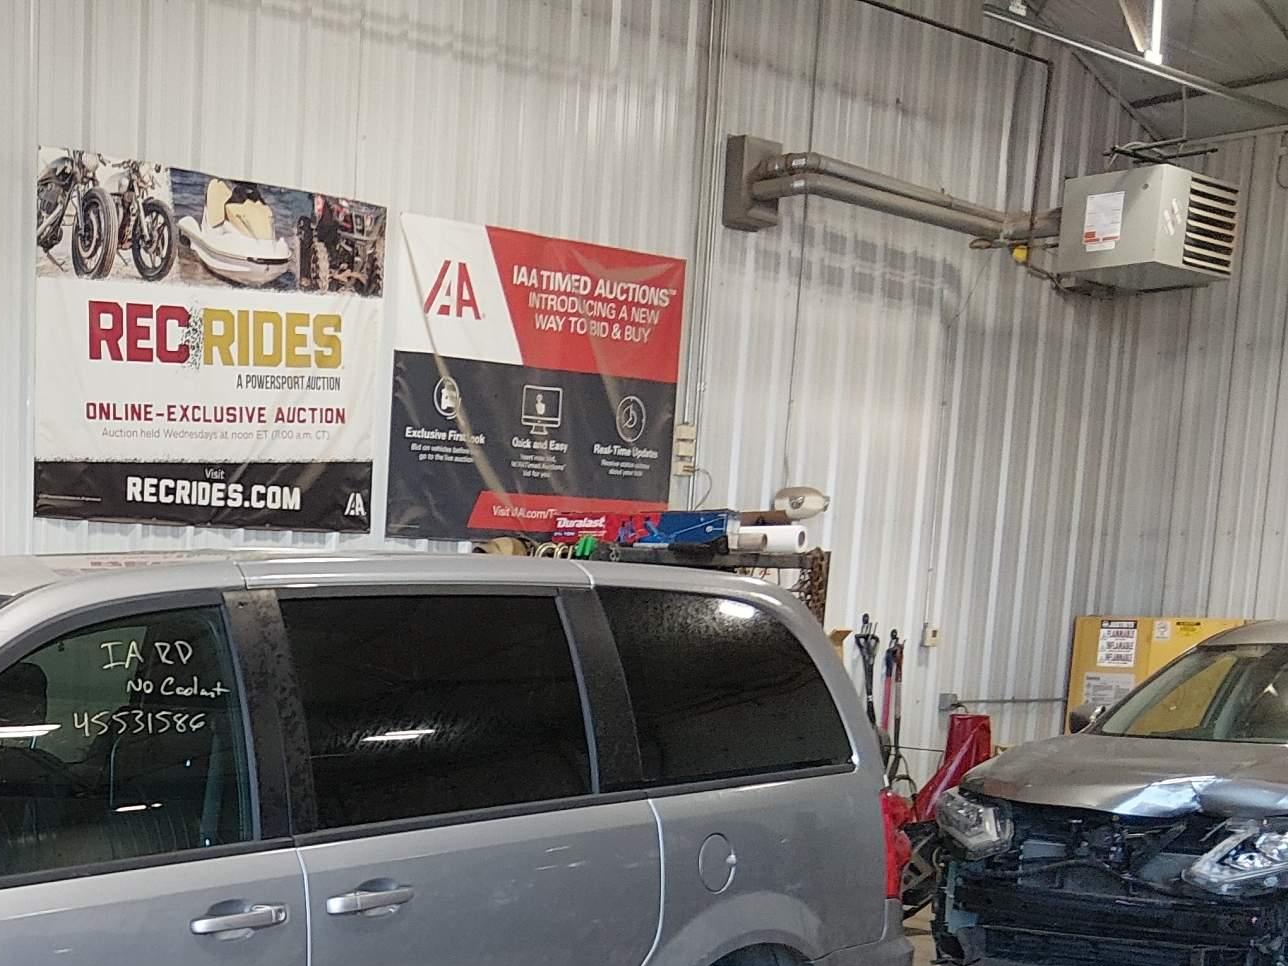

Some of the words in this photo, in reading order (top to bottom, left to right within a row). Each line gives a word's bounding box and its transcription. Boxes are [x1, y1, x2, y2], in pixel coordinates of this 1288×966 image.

[512, 264, 540, 288] IAA
[540, 270, 591, 296] TIMED
[528, 291, 616, 320] INTRODUCING
[618, 308, 628, 321] A
[631, 309, 661, 326] NEW
[88, 299, 191, 364] REC
[202, 307, 344, 369] RIDES
[534, 313, 566, 333] WAY
[569, 316, 587, 335] TO
[589, 321, 610, 339] BID
[611, 325, 622, 340] &
[624, 325, 652, 344] BUY
[236, 374, 243, 389] A
[245, 374, 305, 391] POWERSPORT
[306, 375, 341, 391] AUCTION
[86, 402, 267, 424] ONLINE-EXCLUSIVE
[274, 406, 346, 425] AUCTION
[102, 427, 138, 438] Auction
[140, 428, 161, 438] held
[164, 429, 217, 441] Wednesdays
[219, 431, 230, 440] at
[231, 431, 254, 440] noon
[256, 430, 269, 440] ET
[315, 430, 330, 441] CT)
[405, 426, 447, 441] Exclusive
[512, 436, 531, 450] Quick
[532, 439, 547, 450] and
[549, 440, 569, 453] Easy
[593, 443, 632, 458] Real-Time
[632, 446, 659, 459] Updates
[204, 467, 225, 481] Visit
[126, 476, 301, 511] RECRIDES.COM
[492, 505, 511, 516] Visit
[555, 515, 607, 529] Duralast
[73, 709, 206, 737] 45531586
